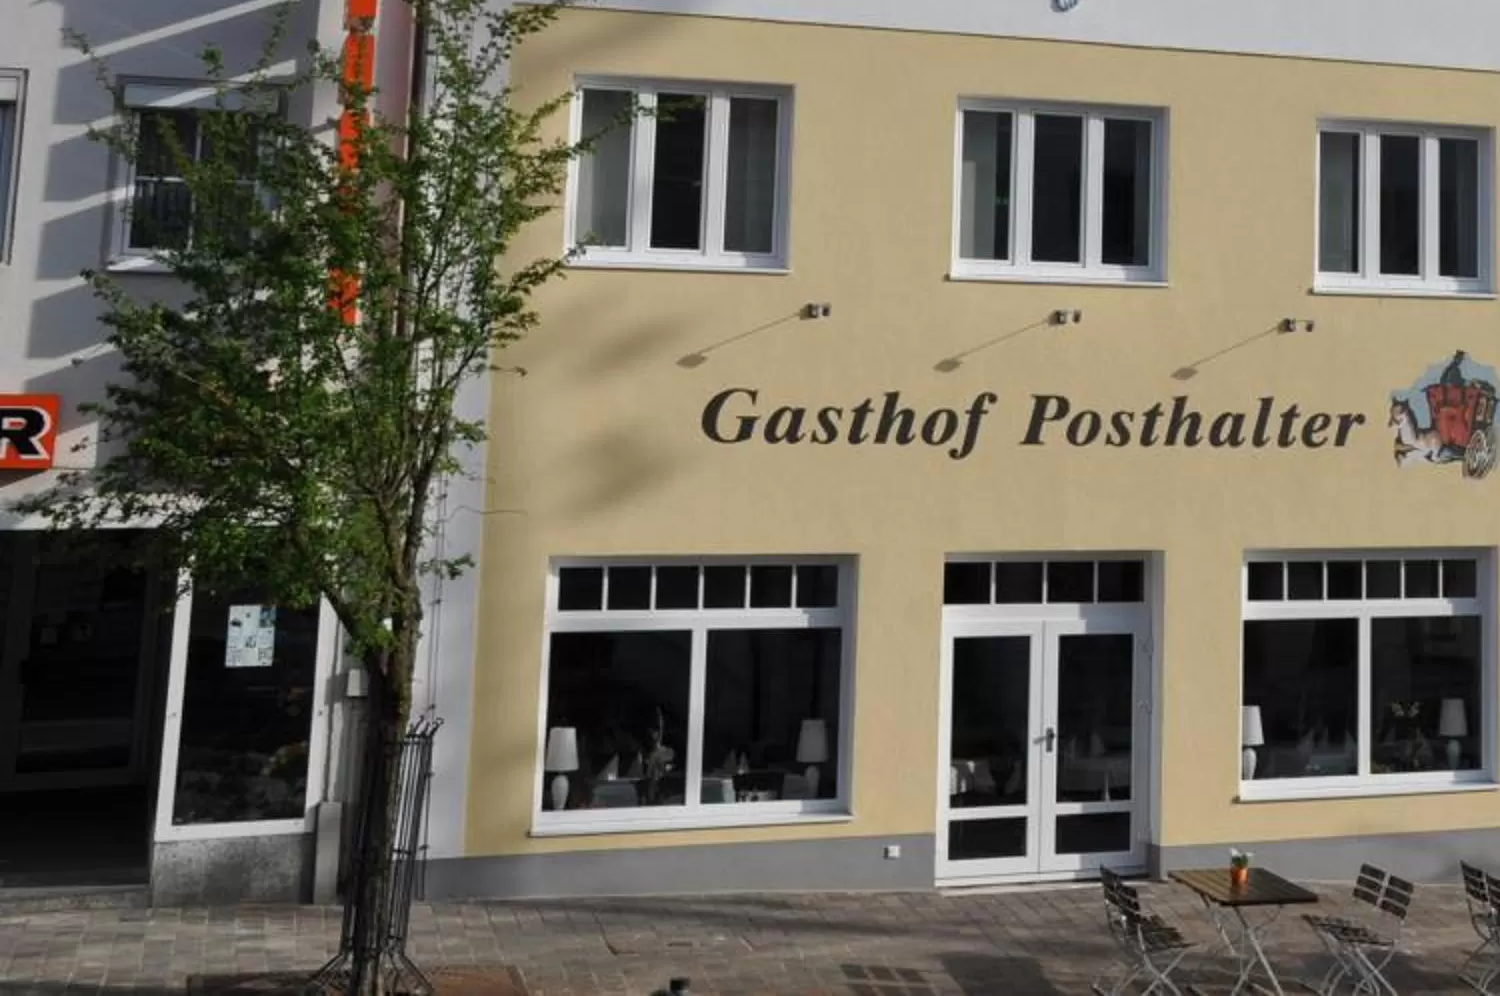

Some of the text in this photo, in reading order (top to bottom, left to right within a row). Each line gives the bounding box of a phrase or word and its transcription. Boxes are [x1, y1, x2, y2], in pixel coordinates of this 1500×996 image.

[0, 405, 50, 460] R
[701, 388, 1366, 460] Gasthof Posthalter
